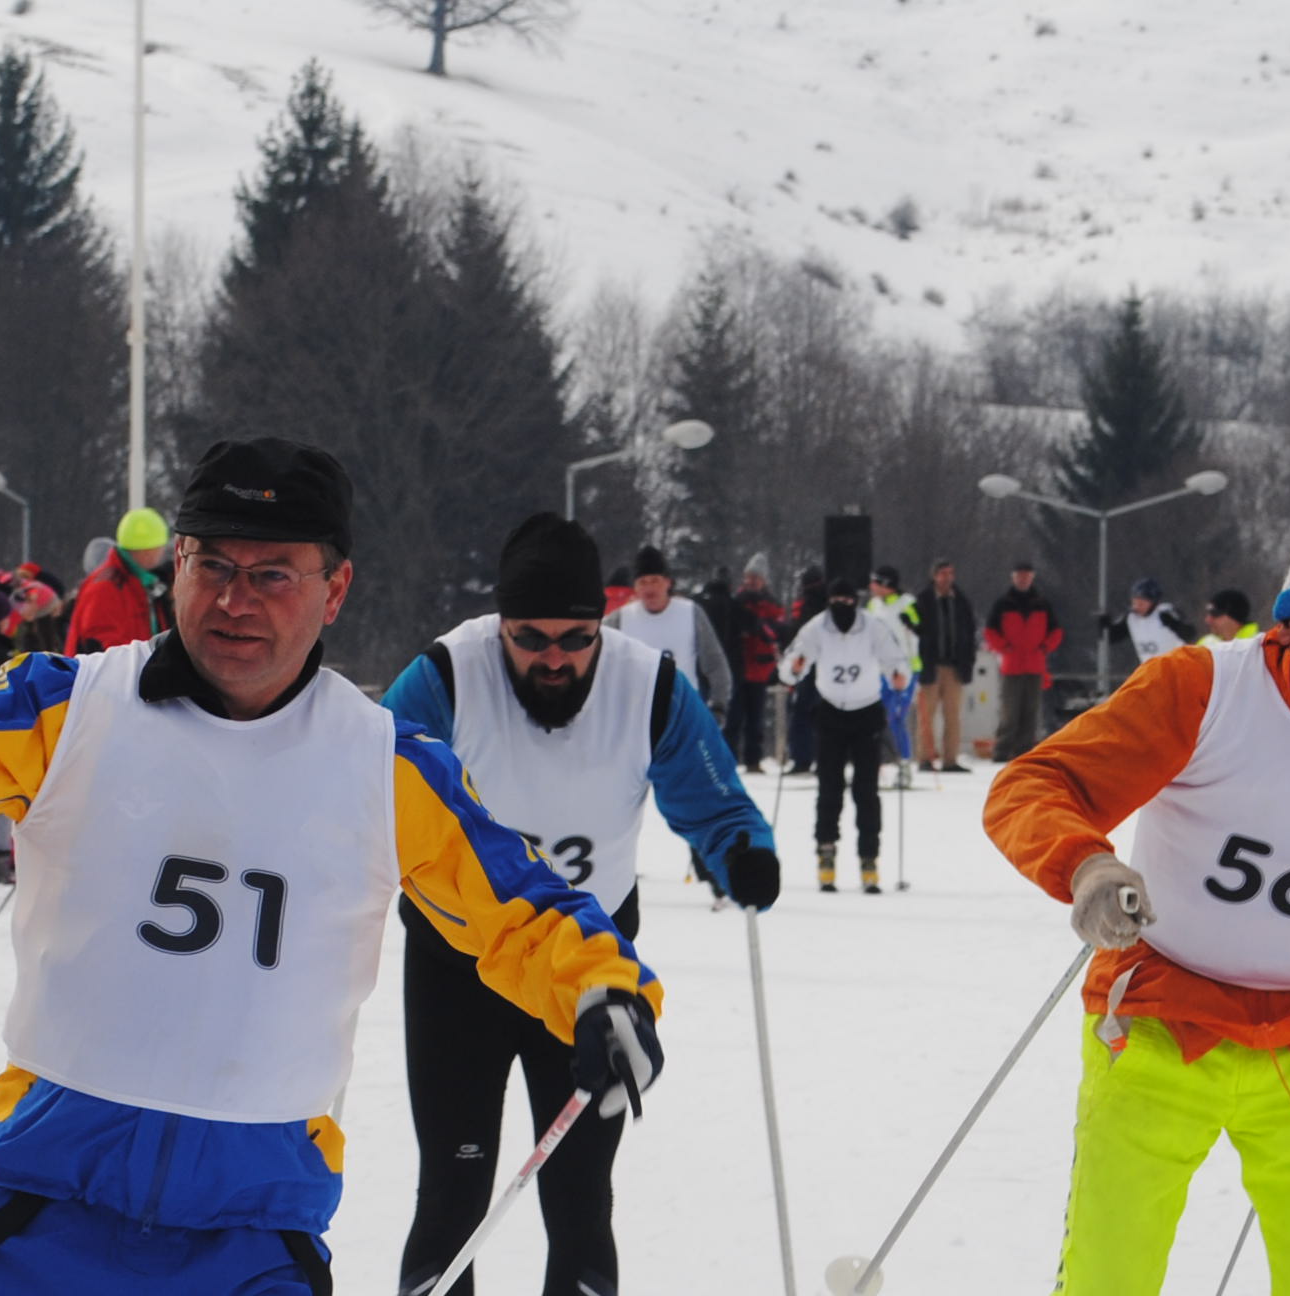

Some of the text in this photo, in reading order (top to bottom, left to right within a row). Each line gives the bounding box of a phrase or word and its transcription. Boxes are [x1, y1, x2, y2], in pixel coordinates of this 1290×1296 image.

[832, 664, 861, 684] 29
[515, 830, 594, 886] 3
[137, 855, 288, 970] 51
